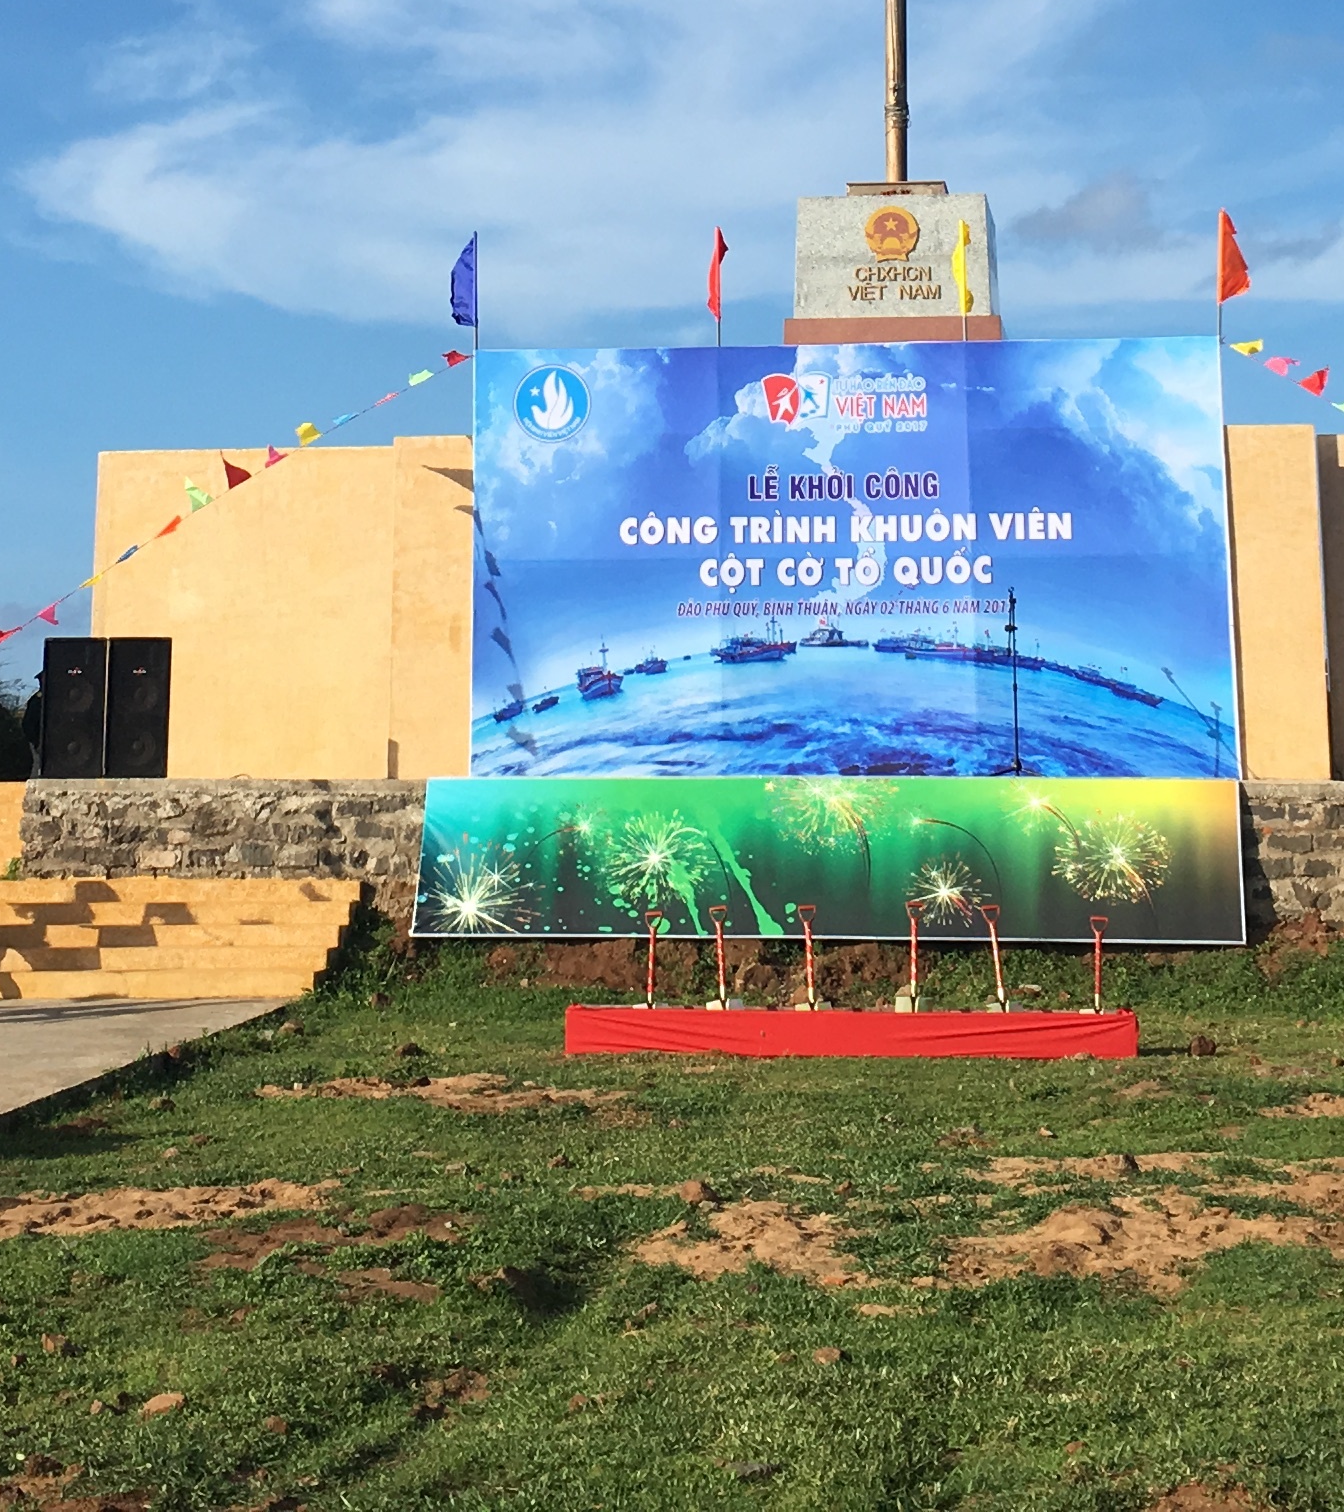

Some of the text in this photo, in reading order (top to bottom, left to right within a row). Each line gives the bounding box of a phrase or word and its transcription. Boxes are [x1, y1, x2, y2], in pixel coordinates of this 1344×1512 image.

[854, 266, 932, 282] CHXHCN
[847, 283, 942, 305] VIỆT NAM
[834, 393, 928, 423] VIỆT NAM
[896, 420, 928, 432] 2017
[748, 464, 940, 501] LỄ KHỞI CÔNG
[619, 506, 1073, 545] CÔNG TRÌNH KHUÔN VIÊN
[699, 546, 993, 594] CỘT CỜ TỔ QUỐC
[845, 597, 878, 615] NGÀY
[880, 601, 895, 615] 02
[898, 596, 939, 614] THÁNG
[942, 600, 950, 614] 6
[953, 596, 980, 614] NĂM
[983, 599, 1008, 613] 201
